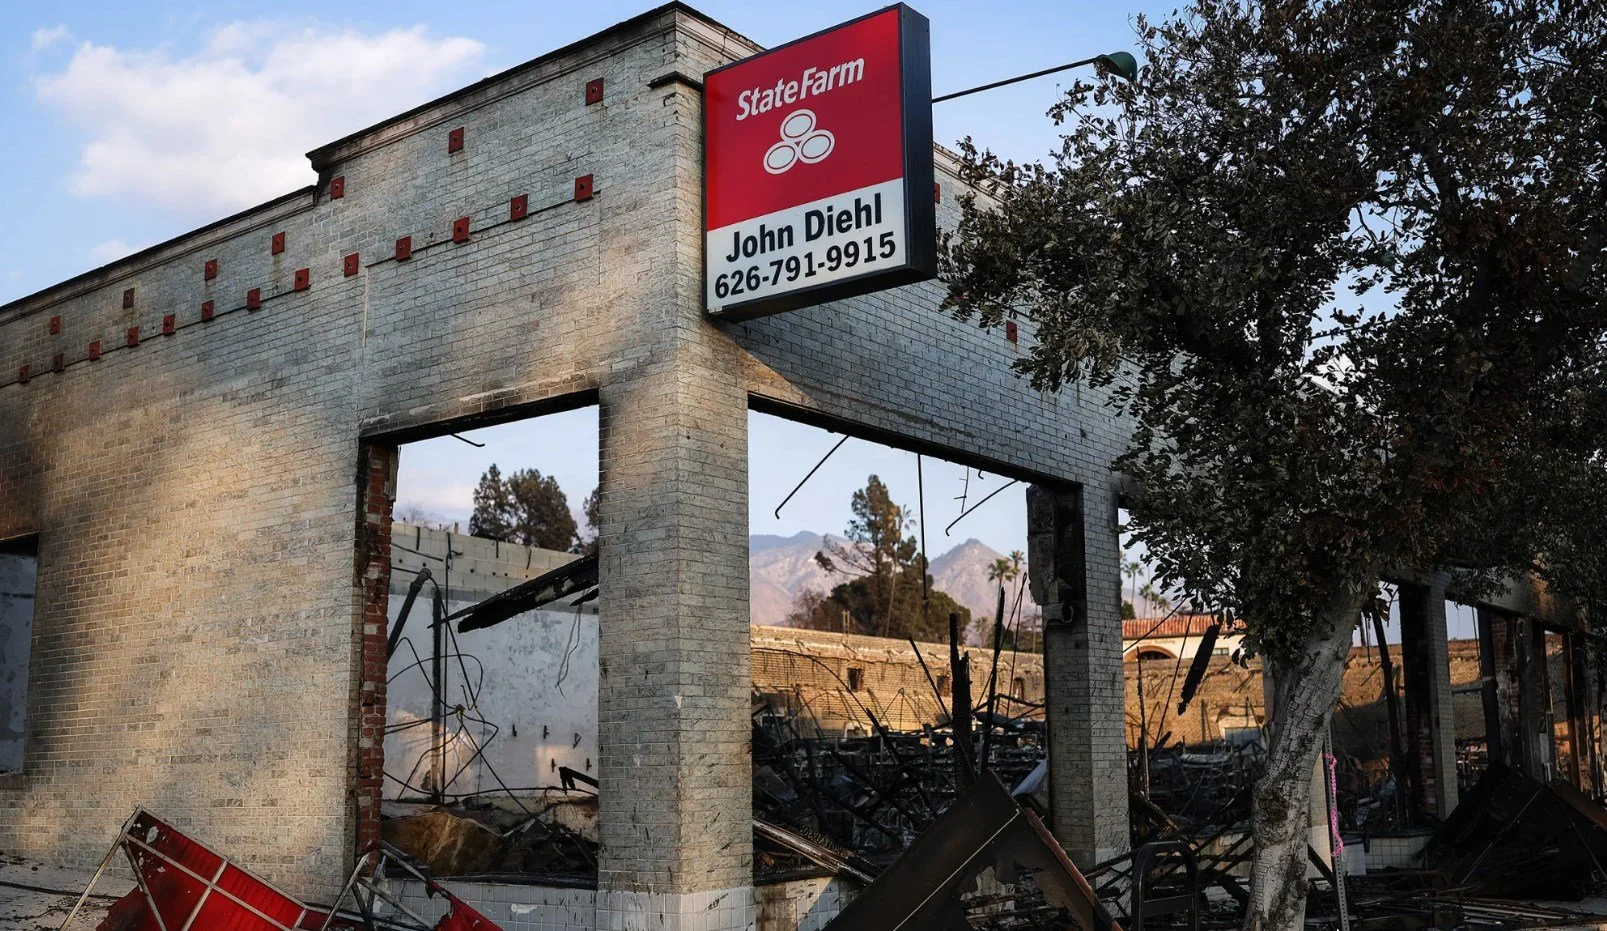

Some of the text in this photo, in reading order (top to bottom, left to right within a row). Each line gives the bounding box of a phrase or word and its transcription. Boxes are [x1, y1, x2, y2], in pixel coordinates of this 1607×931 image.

[726, 192, 882, 262] John Diehl
[714, 231, 896, 299] 626-791-9915
